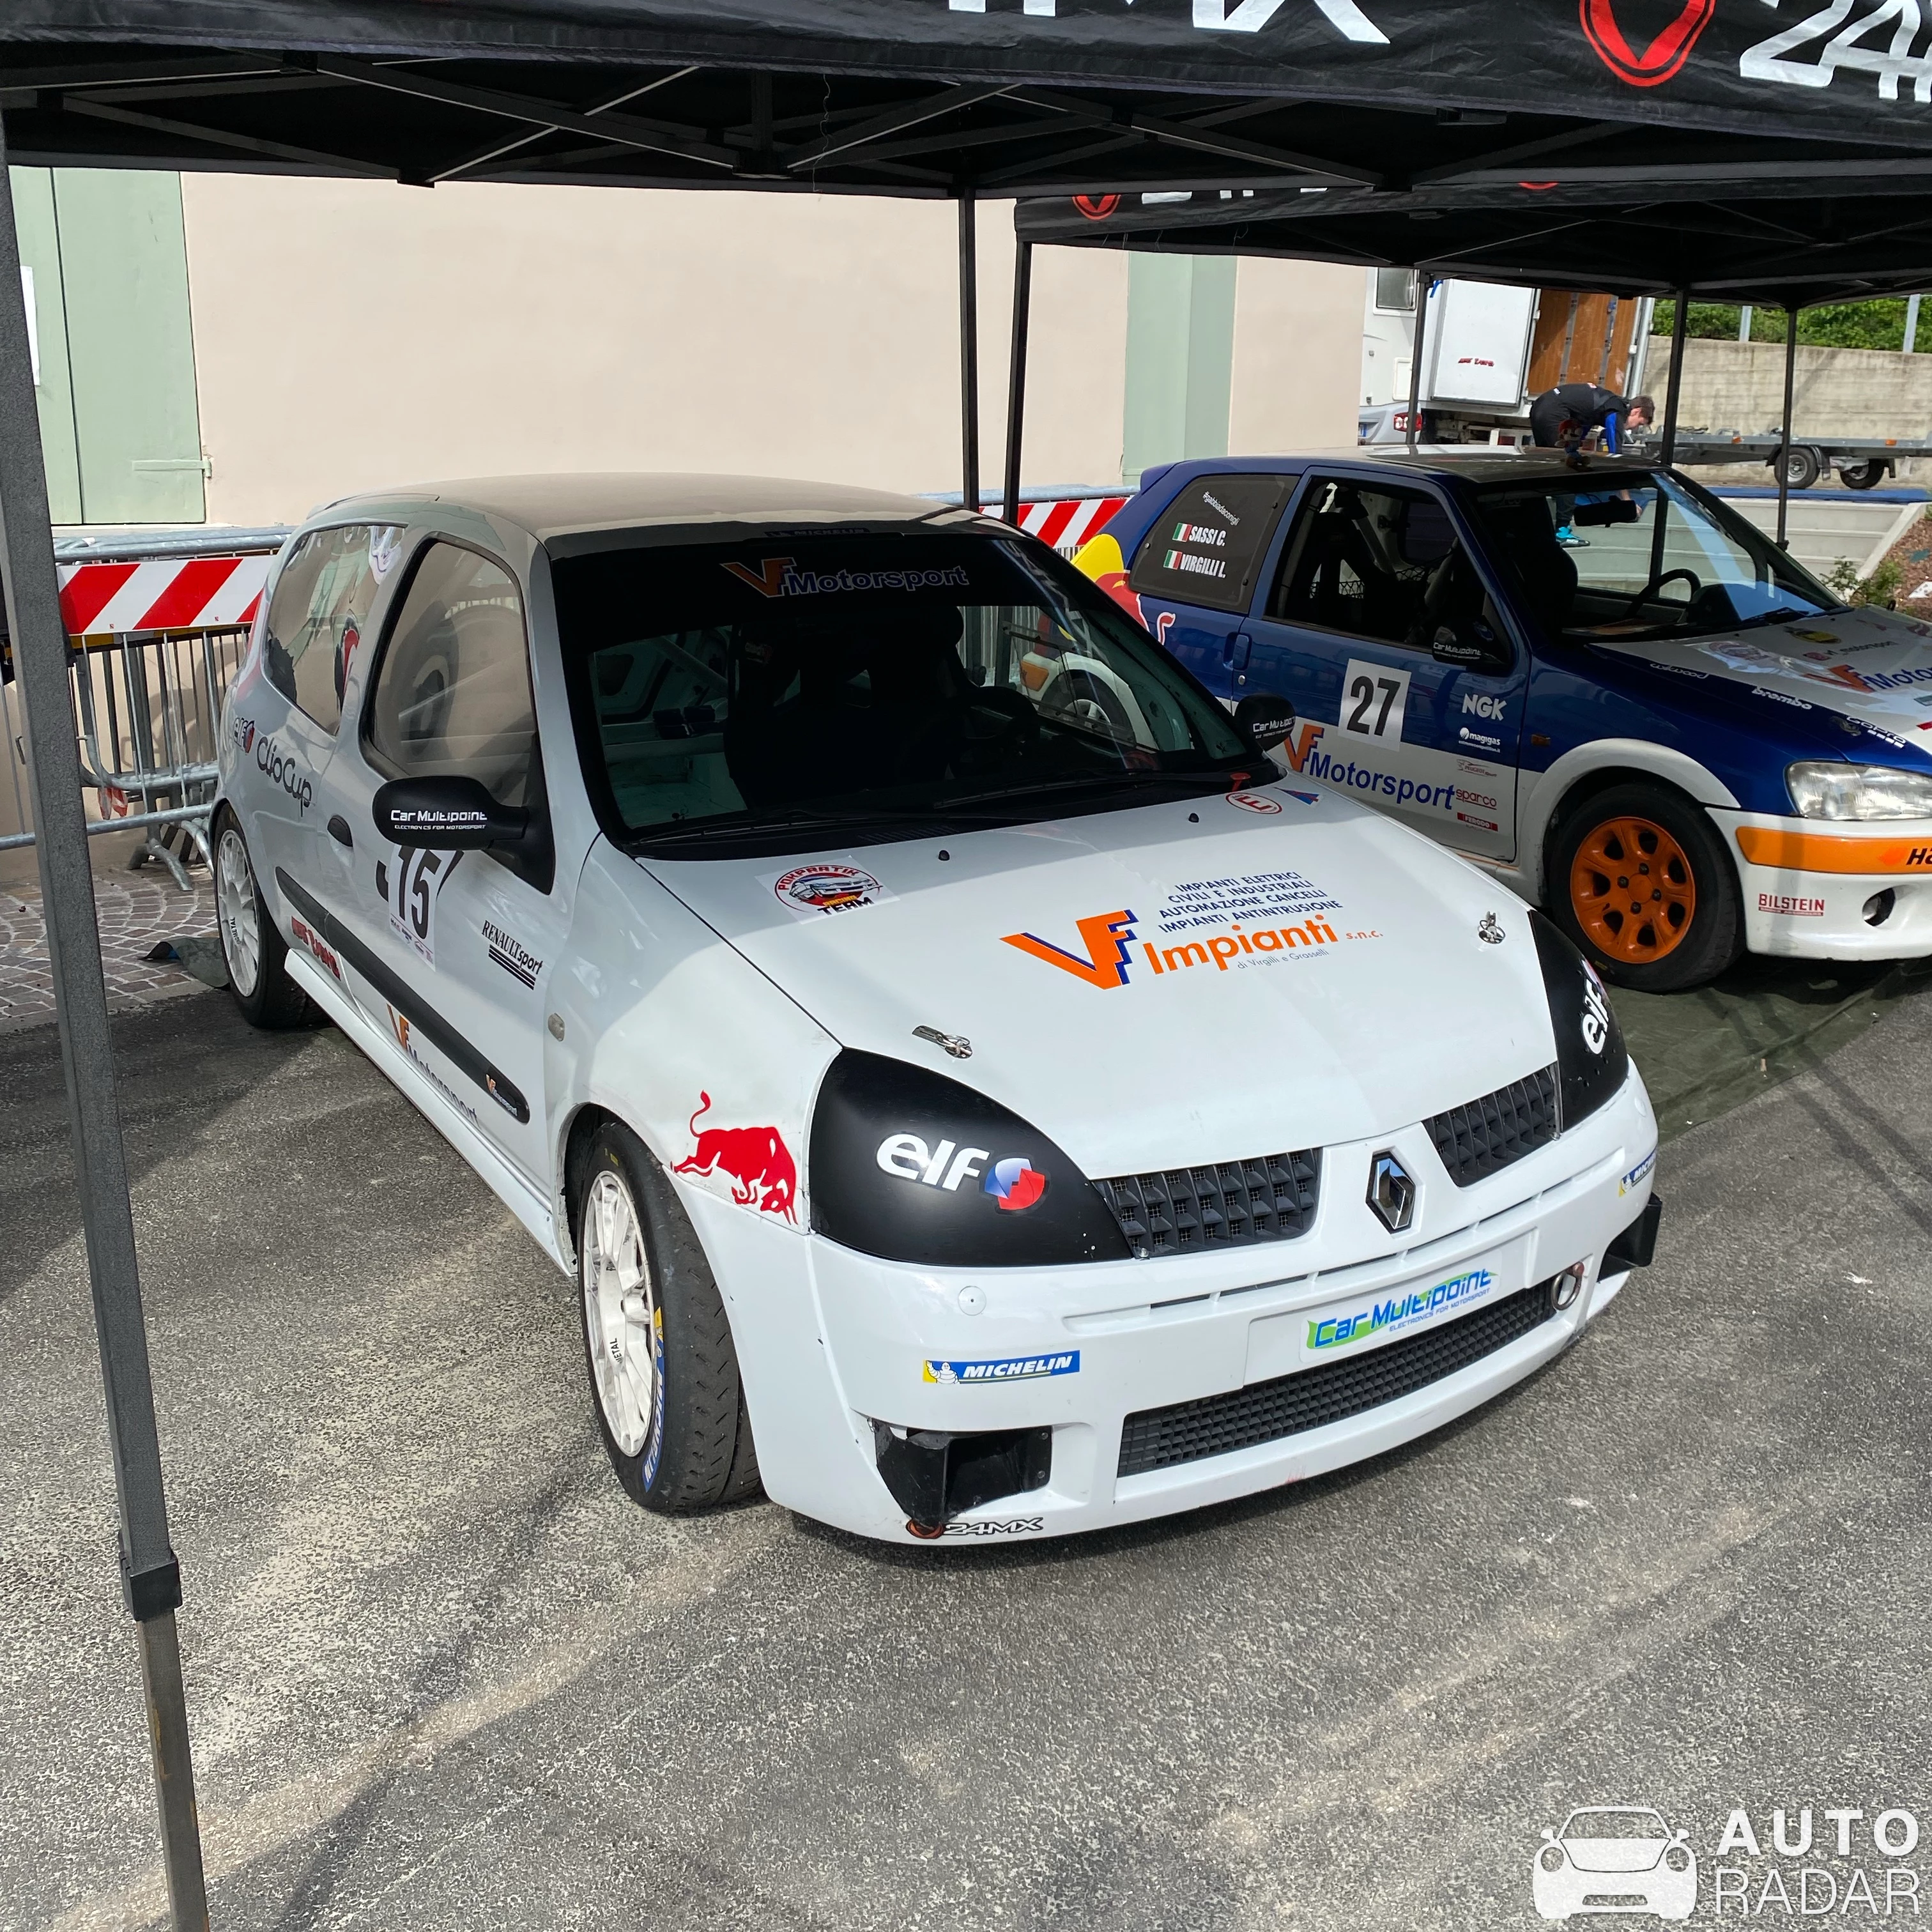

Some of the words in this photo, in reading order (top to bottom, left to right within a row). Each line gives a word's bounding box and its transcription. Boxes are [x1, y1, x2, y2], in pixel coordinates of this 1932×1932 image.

[1189, 526, 1218, 544] SASSI
[1216, 530, 1226, 546] C.
[1179, 553, 1220, 576] VIRGILLI
[1218, 562, 1226, 578] L.
[783, 565, 969, 595] Motorsport
[1863, 668, 1932, 689] Moto
[1347, 676, 1401, 737] 27
[1462, 693, 1507, 721] NGK
[1752, 686, 1812, 710] brembo
[1253, 723, 1269, 732] Car
[1469, 733, 1501, 746] magigas
[1310, 752, 1454, 809] Motorsport
[1456, 789, 1497, 807] sparco
[391, 810, 416, 822] Car
[417, 811, 487, 822] Multipoint
[1464, 816, 1491, 829] FERODO
[398, 845, 442, 939] 15
[1168, 891, 1211, 903] CIVILI
[1227, 880, 1314, 896] INDUSTRIALI
[1175, 878, 1239, 892] IMPIANTI
[1241, 872, 1303, 884] ELETTRICI
[1159, 898, 1264, 918] AUTOMAZIONE
[1266, 890, 1328, 902] CANCELLI
[1759, 893, 1825, 910] BILSTEIN
[1158, 914, 1229, 933] IMPIANTI
[1233, 900, 1344, 920] ANTINTRUSIONE
[999, 909, 1138, 990] VF
[1143, 914, 1338, 975] Impianti
[1346, 930, 1384, 940] s.n.c.
[1238, 961, 1248, 969] di
[1248, 956, 1280, 968] Virgilli
[1291, 947, 1330, 960] Grasselli
[1582, 979, 1609, 1055] elf
[877, 1133, 990, 1191] elf
[1314, 1312, 1368, 1347] Car
[1371, 1269, 1491, 1329] Multipoint
[1390, 1311, 1434, 1331] ELECTRONICS
[1436, 1305, 1449, 1315] FOR
[1451, 1288, 1491, 1309] MOTORSPORT
[963, 1355, 1073, 1378] MICHELIN
[945, 1517, 1044, 1535] 24MX
